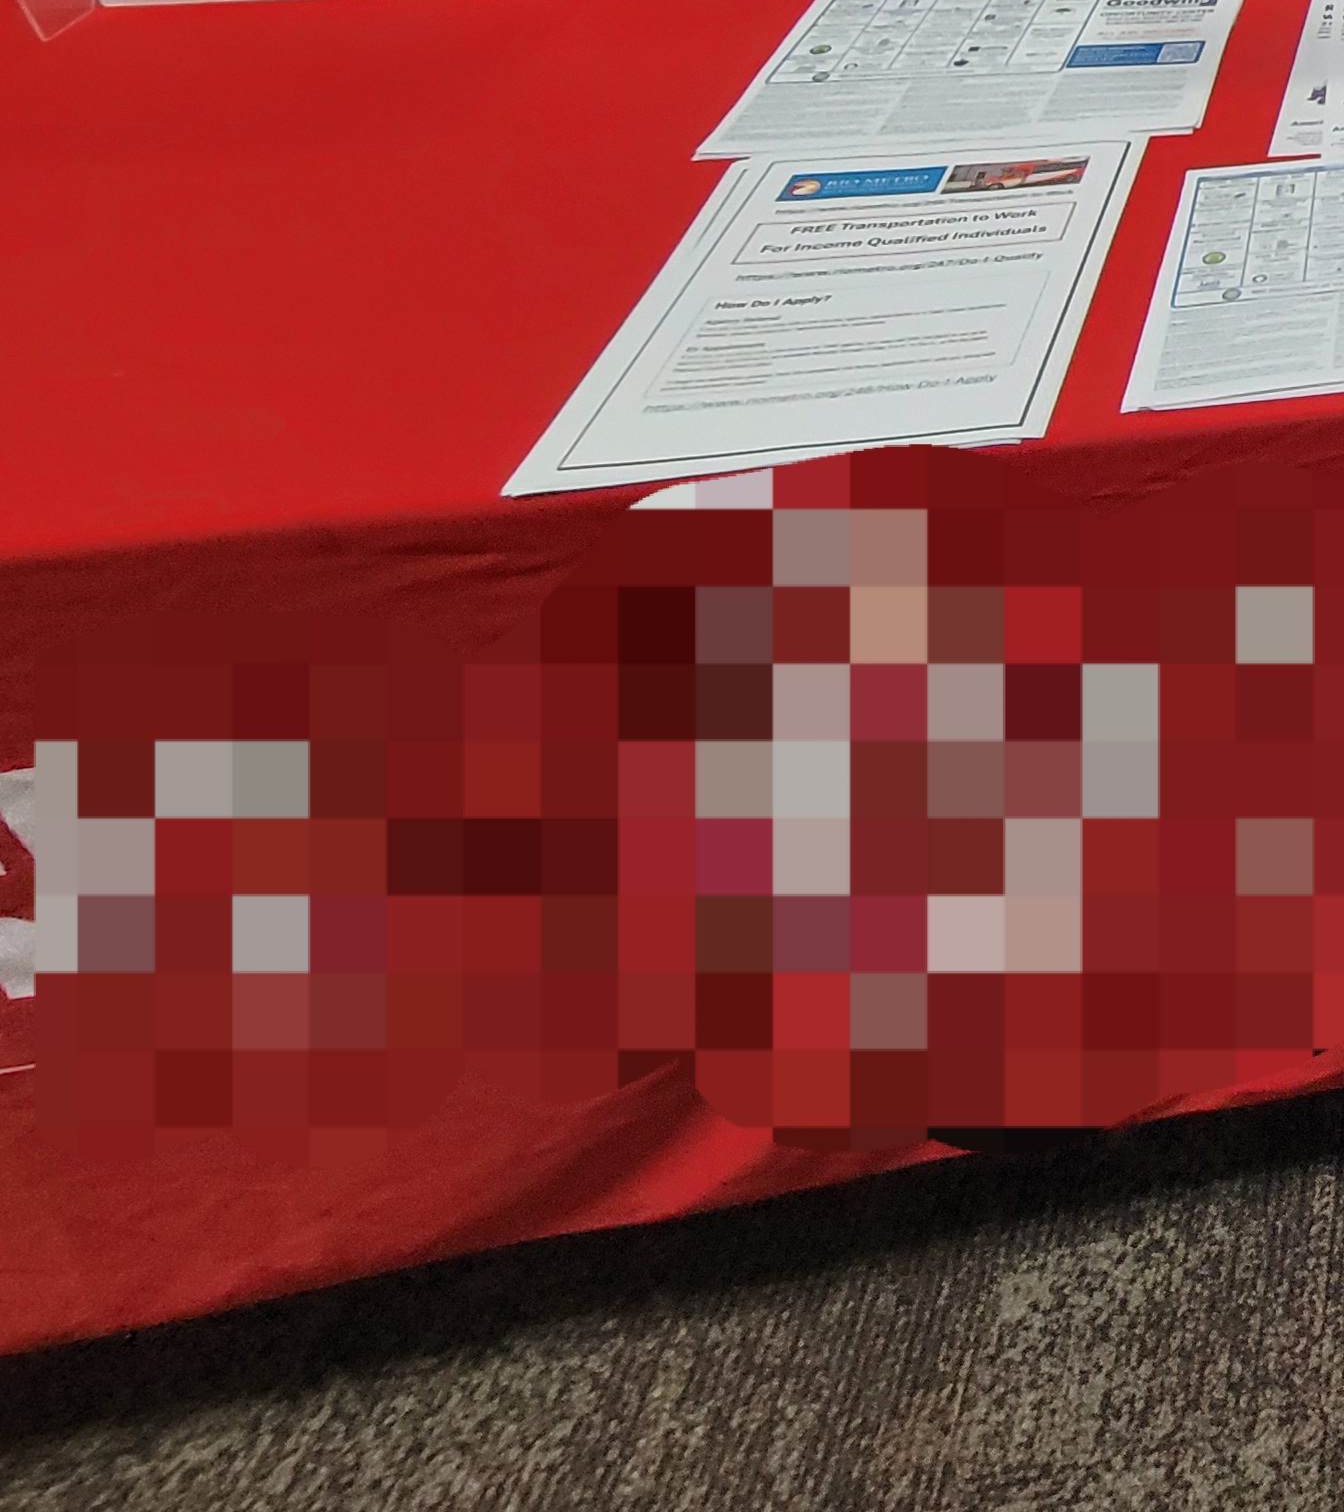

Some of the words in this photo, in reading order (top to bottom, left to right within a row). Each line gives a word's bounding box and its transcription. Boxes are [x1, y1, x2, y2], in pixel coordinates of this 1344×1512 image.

[790, 223, 835, 235] FREE
[841, 213, 969, 231] Transportation
[972, 214, 990, 222] to
[994, 209, 1037, 220] Work
[760, 244, 793, 254] For
[795, 240, 863, 253] Income
[867, 233, 948, 248] Qualified
[952, 225, 1047, 241] Individuals
[715, 300, 748, 311] How
[751, 299, 771, 308] Do
[783, 295, 833, 308] Apply?
